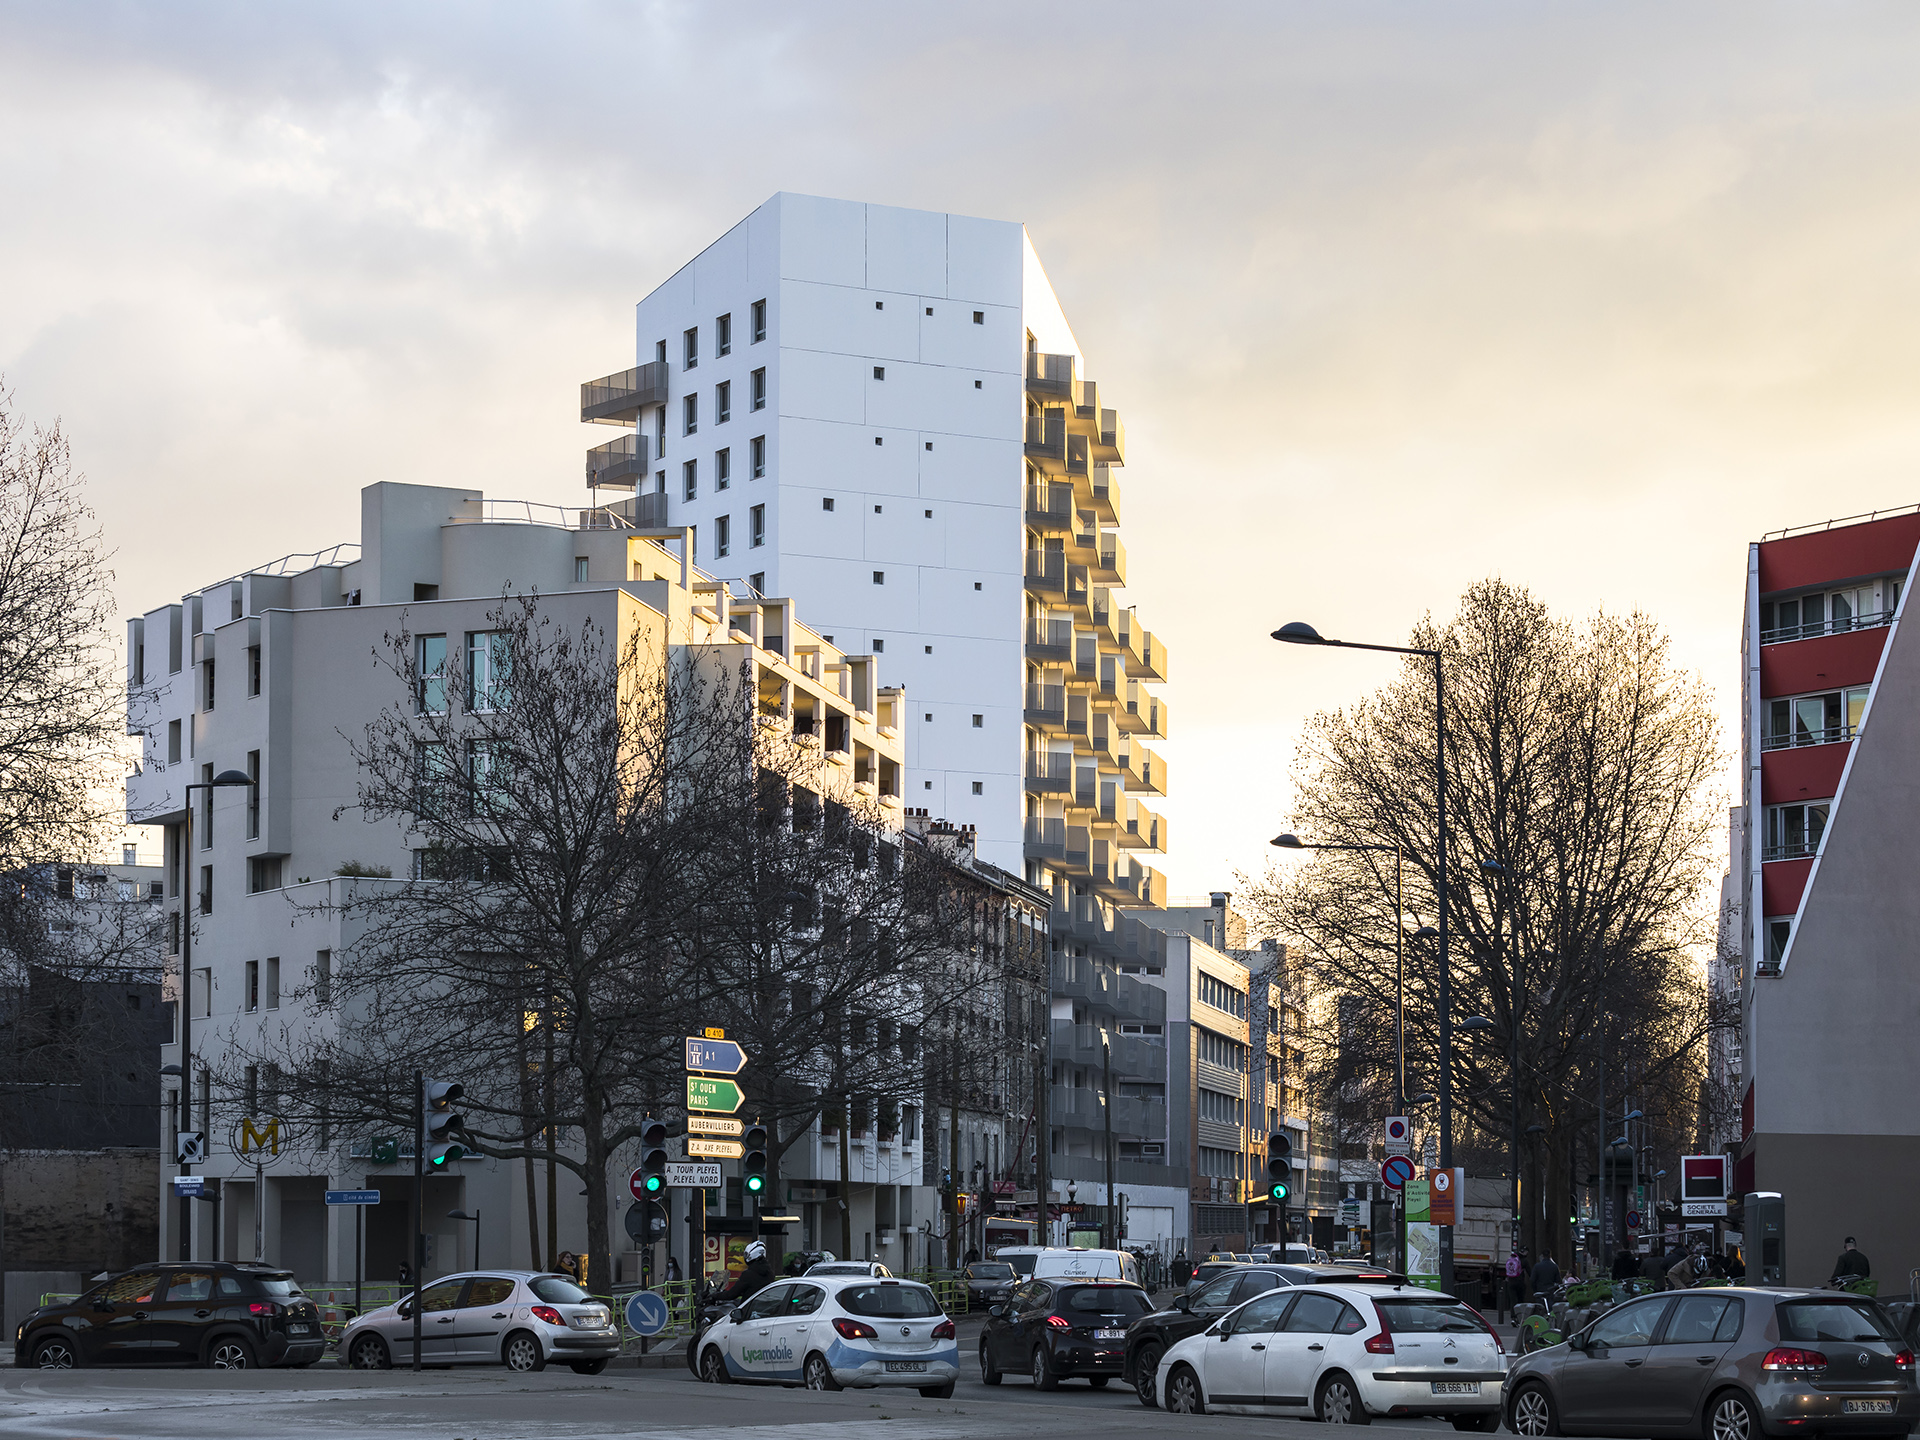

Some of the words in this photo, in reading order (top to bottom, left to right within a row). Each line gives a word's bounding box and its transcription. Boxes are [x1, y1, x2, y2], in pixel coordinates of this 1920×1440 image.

[707, 1029, 712, 1037] D
[712, 1030, 723, 1038] 410
[699, 1082, 717, 1094] OUEN
[690, 1094, 709, 1106] PARIS
[691, 1120, 735, 1132] AUBERVILLIERS
[242, 1117, 279, 1156] M
[703, 1143, 714, 1153] AXE
[715, 1144, 733, 1154] PLEYEL
[676, 1165, 694, 1175] TOUR
[697, 1165, 719, 1175] PLEYEL
[673, 1175, 696, 1184] PLEYEL
[699, 1175, 719, 1185] NORD
[742, 1345, 793, 1364] Lycamobile
